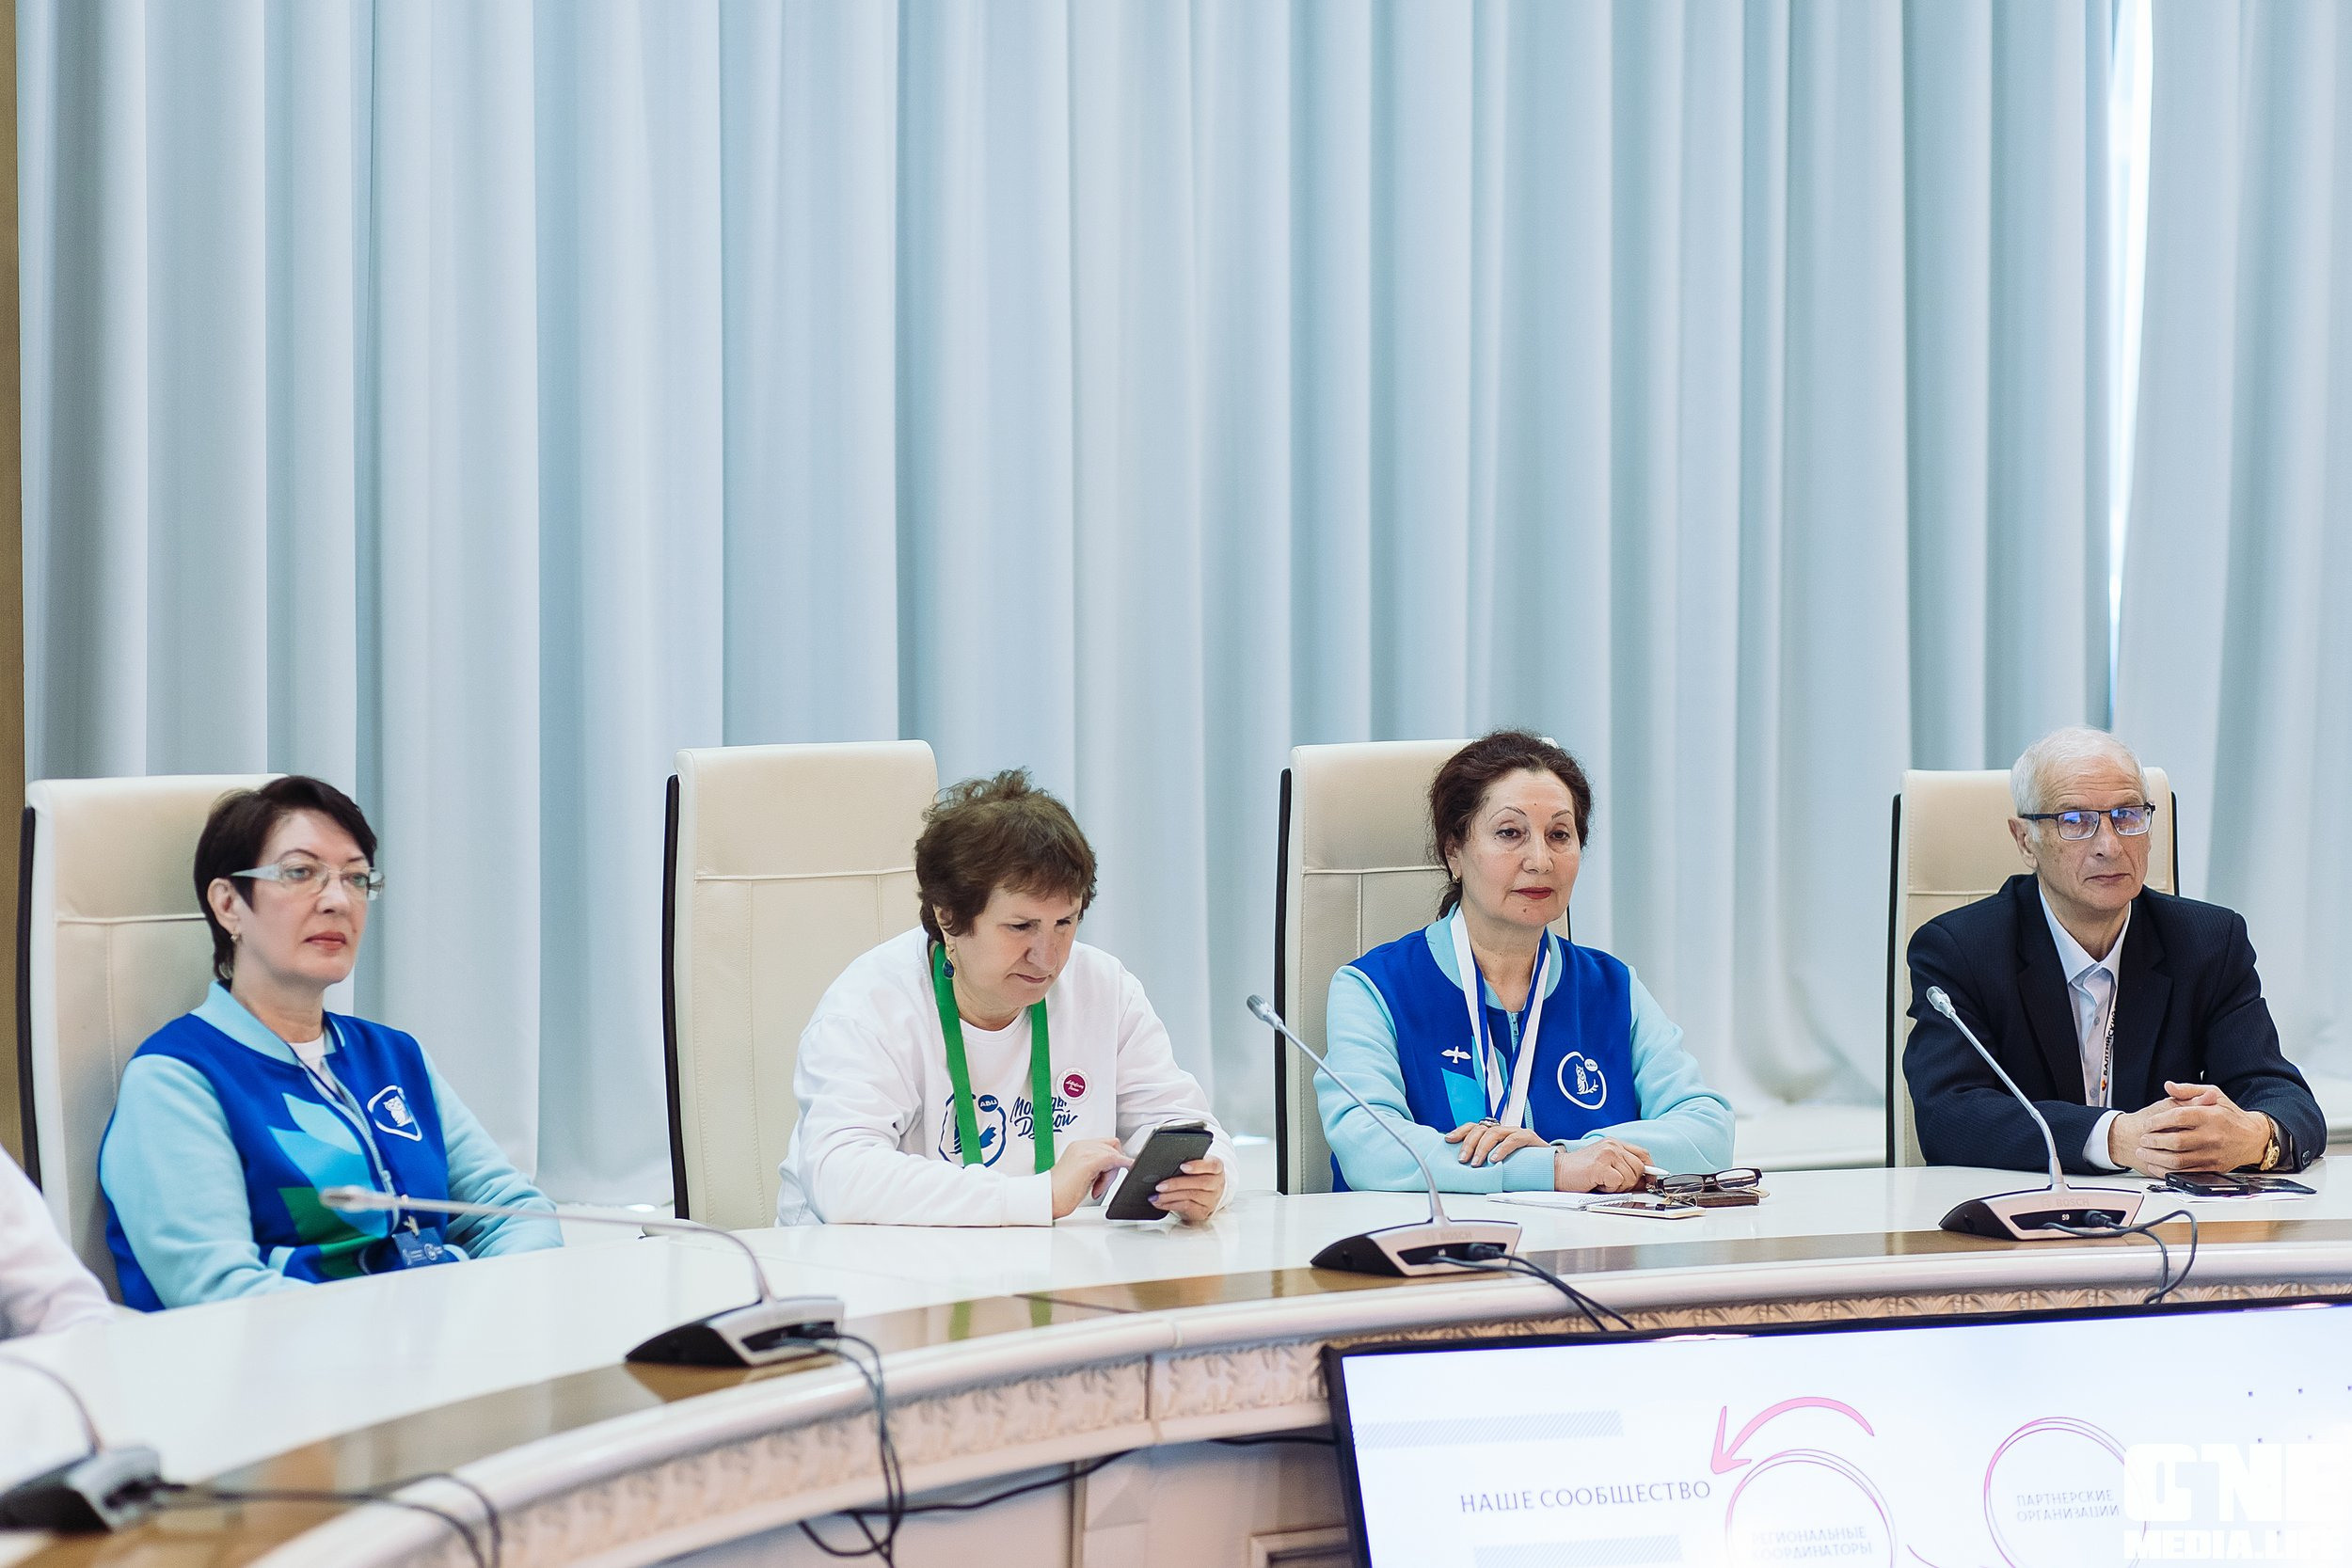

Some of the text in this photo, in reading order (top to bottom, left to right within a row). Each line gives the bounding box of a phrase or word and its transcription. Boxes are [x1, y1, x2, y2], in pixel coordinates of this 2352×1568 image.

[2056, 1198, 2090, 1207] BOSCH
[1439, 1231, 1472, 1241] BOSCH
[1460, 1481, 1711, 1513] НАШЕ СООБЩЕСТВО
[2016, 1489, 2115, 1507] ПАРТНЕРСКИЕ
[2016, 1504, 2121, 1523] ОРГАНИЗАЦИИ
[1752, 1526, 1867, 1545] РЕГИОНАЛЬНЫЕ
[1752, 1542, 1873, 1563] КООРДИНАТОРЫ
